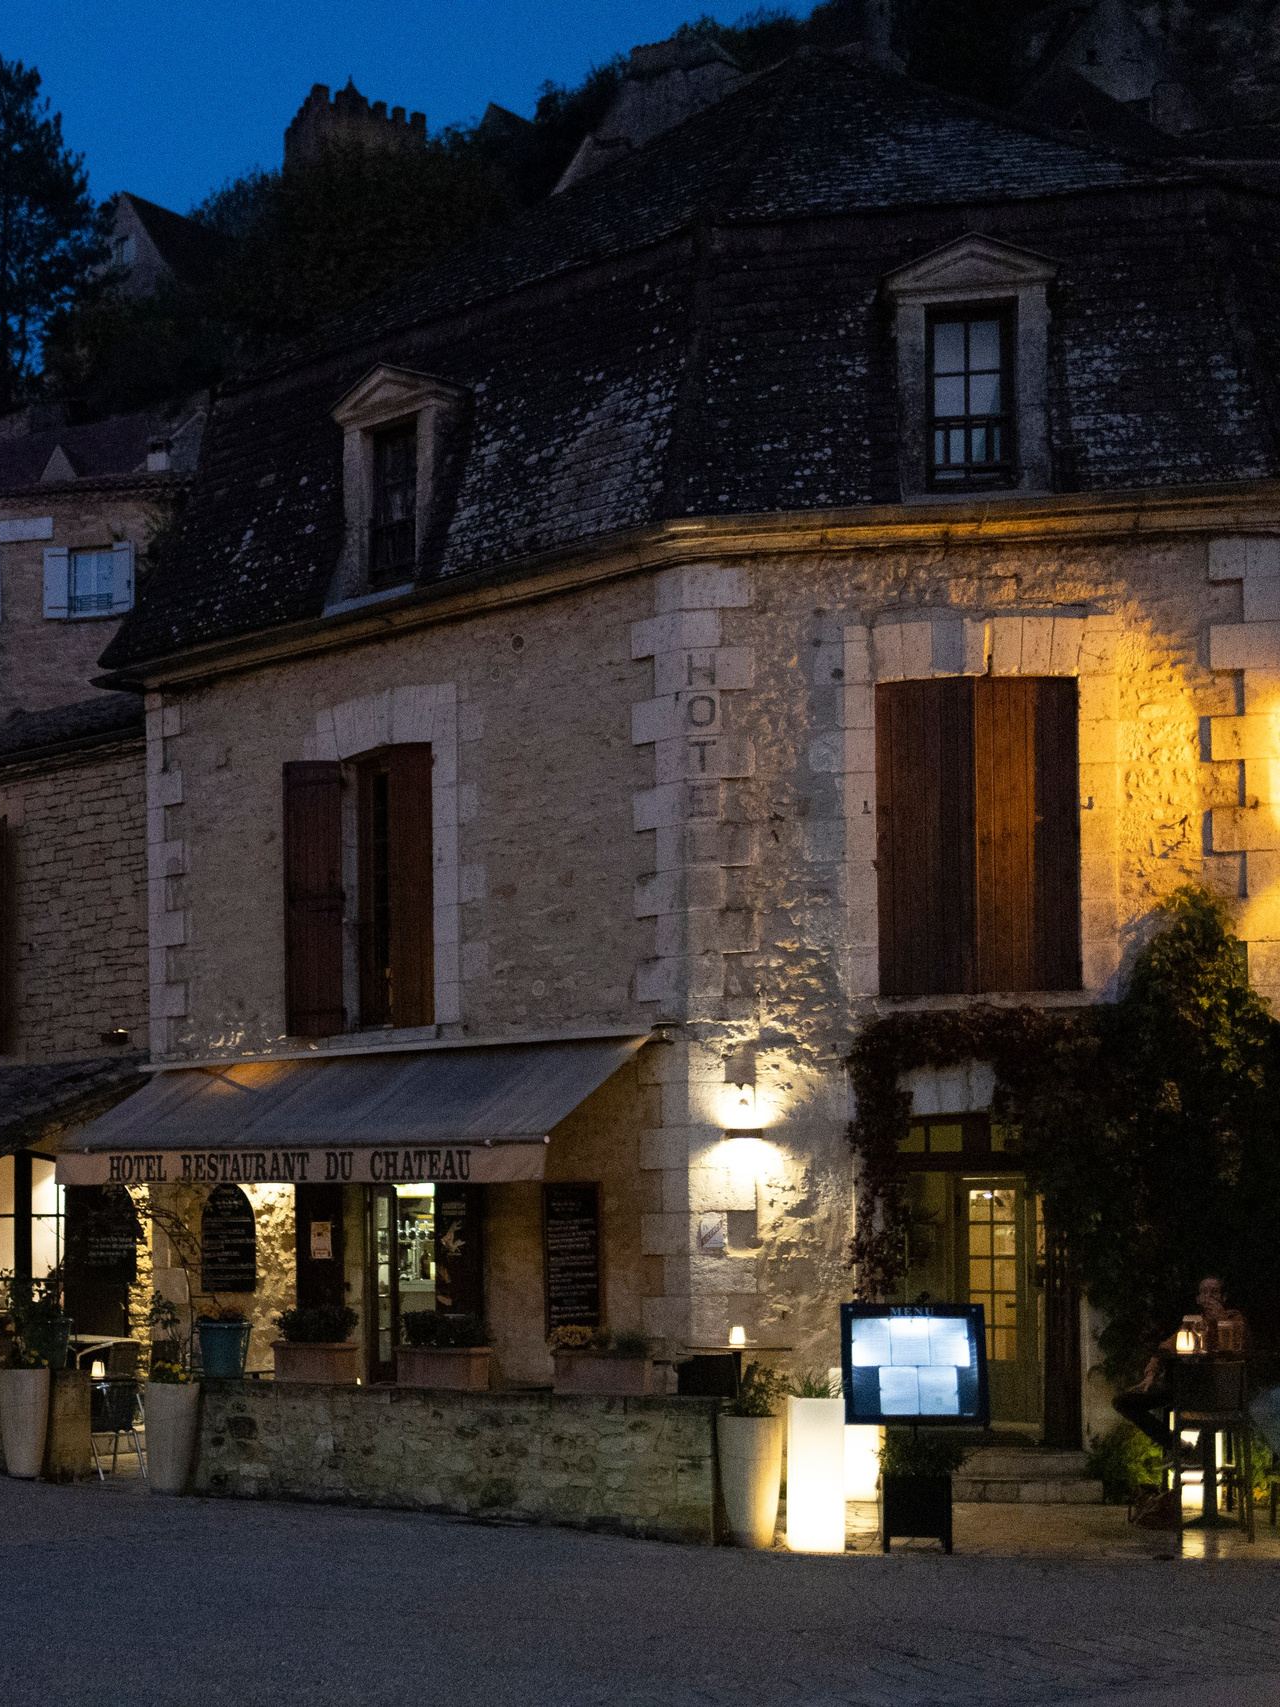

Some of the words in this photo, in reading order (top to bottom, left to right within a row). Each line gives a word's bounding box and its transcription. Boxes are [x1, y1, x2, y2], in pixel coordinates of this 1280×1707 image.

[109, 1154, 167, 1182] HOTEL
[180, 1152, 310, 1182] RESTAURANT
[324, 1151, 354, 1181] DU
[370, 1149, 472, 1181] CHATEAU
[890, 1306, 935, 1317] MENU
